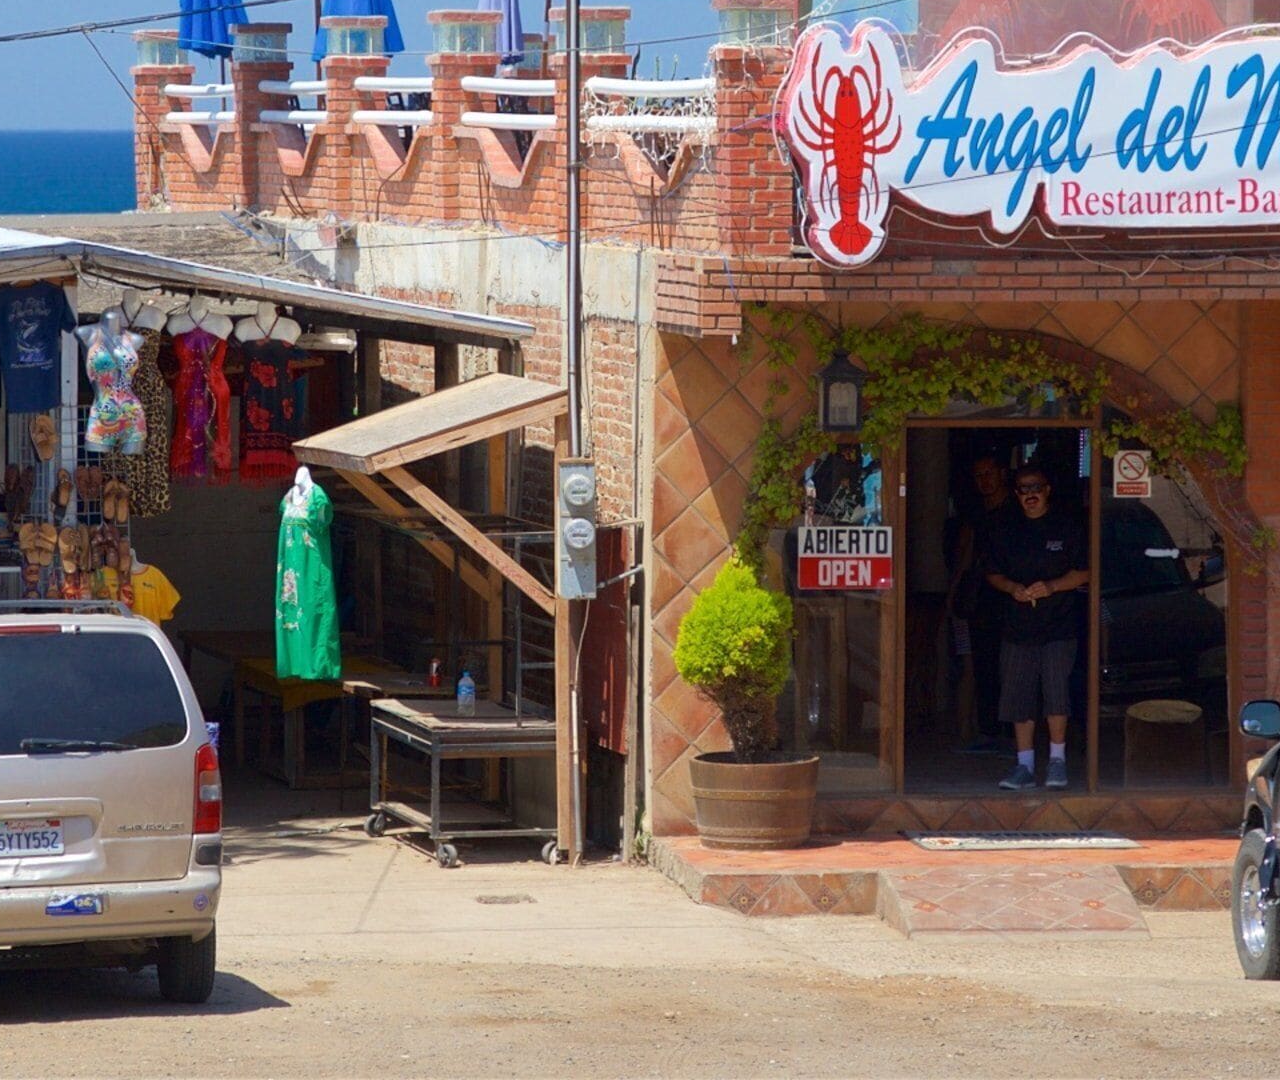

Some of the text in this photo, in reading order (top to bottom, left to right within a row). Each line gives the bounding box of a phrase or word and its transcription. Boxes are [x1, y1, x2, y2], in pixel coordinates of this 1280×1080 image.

[904, 58, 1097, 217] Angel
[1115, 64, 1212, 173] del
[803, 529, 888, 554] ABIERTO
[818, 560, 871, 587] OPEN
